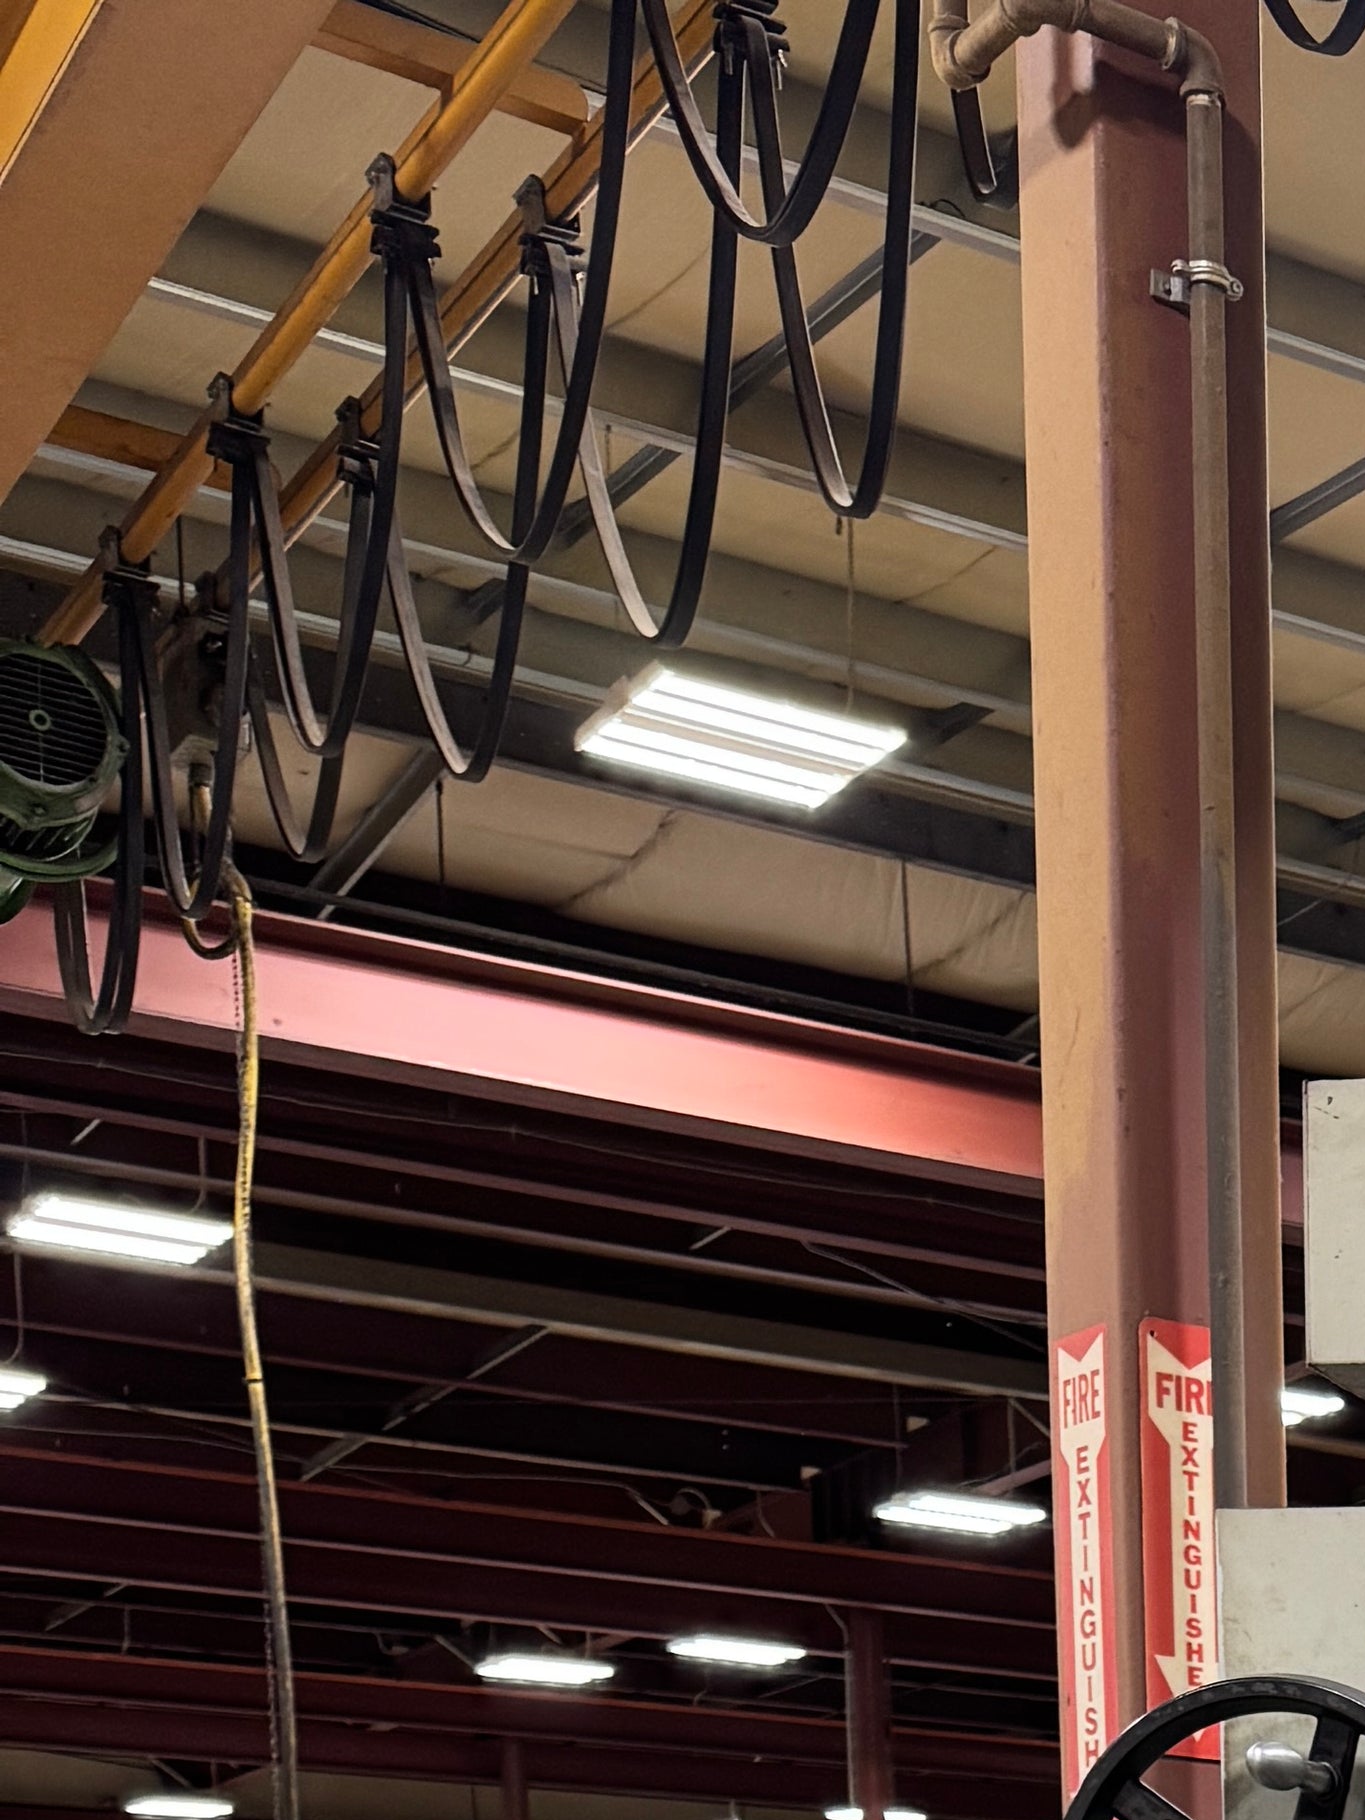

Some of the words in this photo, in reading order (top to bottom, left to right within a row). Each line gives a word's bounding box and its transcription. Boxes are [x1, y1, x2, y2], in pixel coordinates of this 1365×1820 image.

[1063, 1369, 1101, 1430] FIRE
[1075, 1445, 1100, 1767] EXTINGUISH
[1181, 1421, 1203, 1687] EXTINGUISHE
